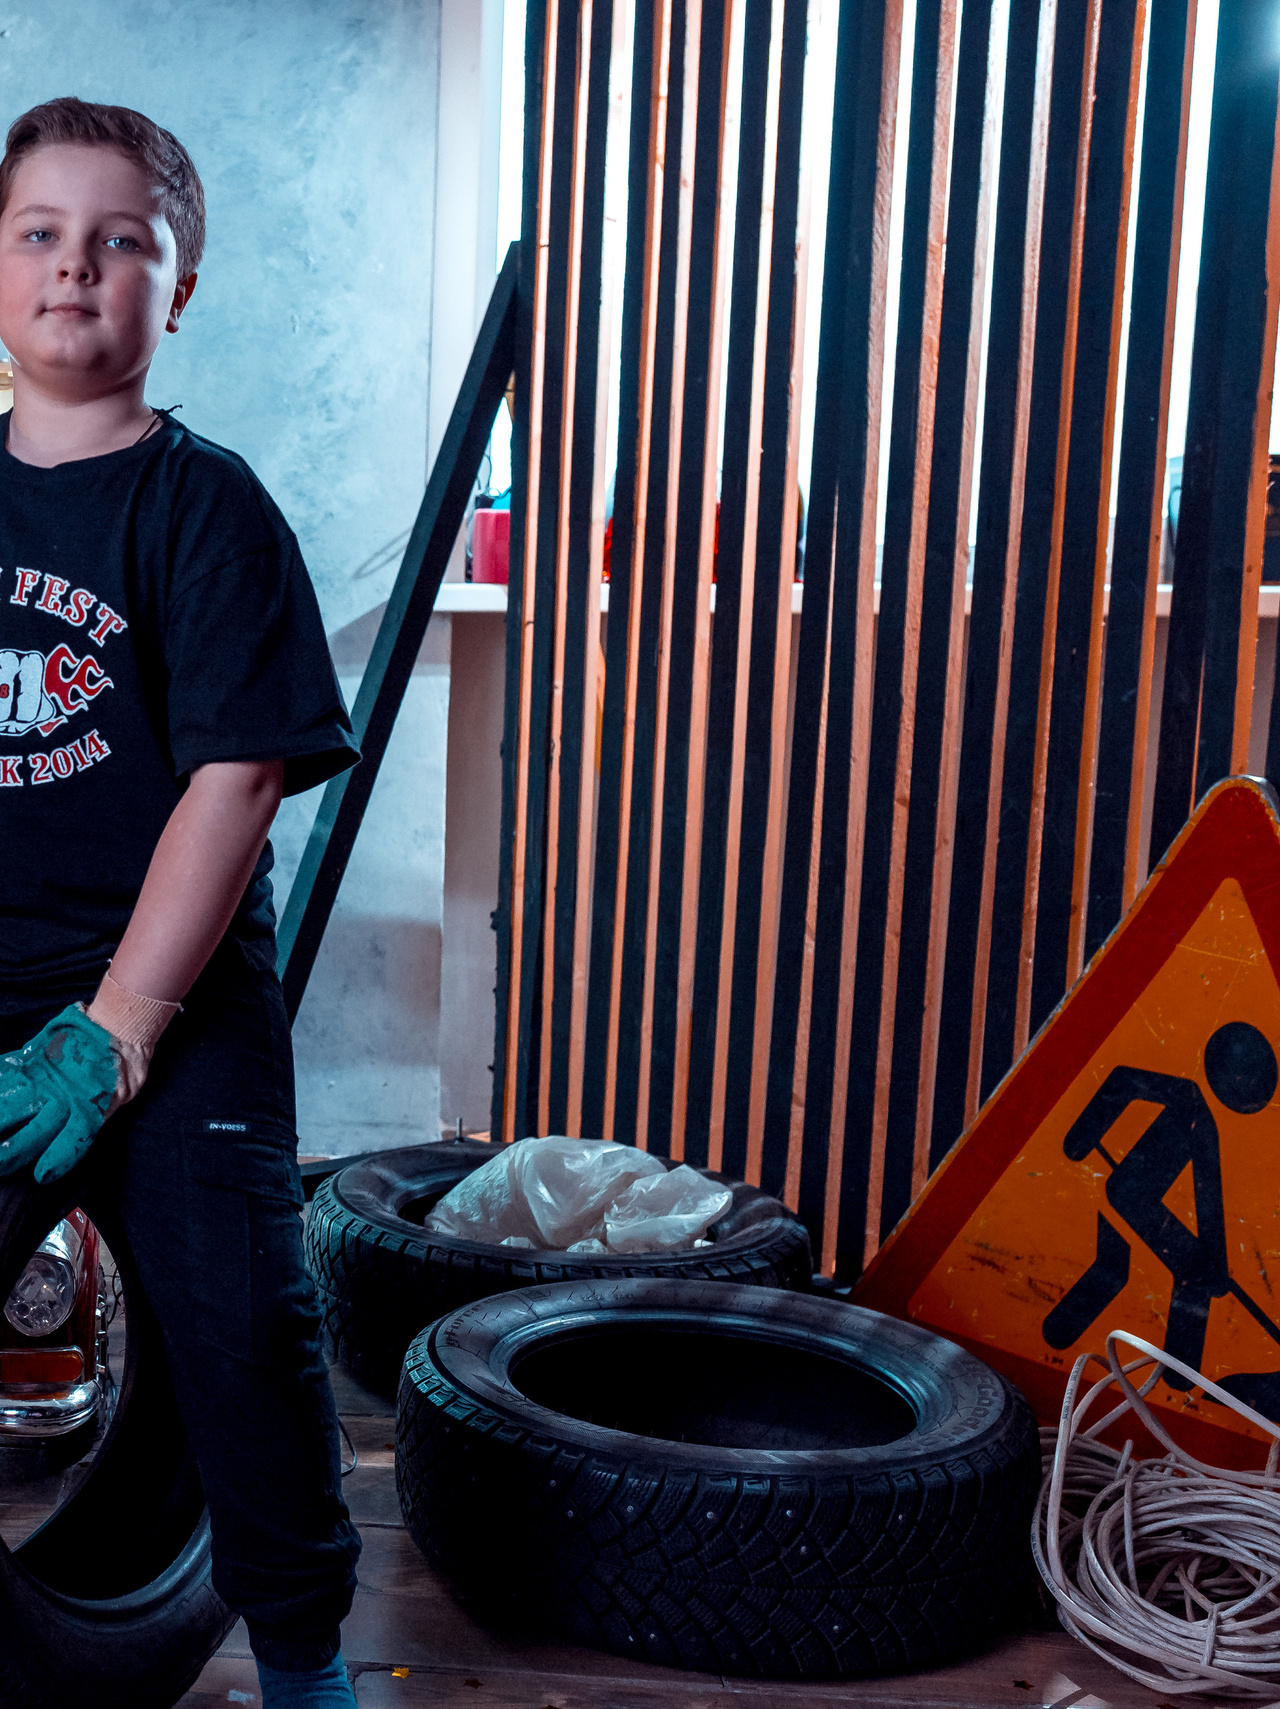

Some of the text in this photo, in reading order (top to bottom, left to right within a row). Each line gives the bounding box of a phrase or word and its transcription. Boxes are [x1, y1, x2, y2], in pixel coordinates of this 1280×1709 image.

[10, 567, 128, 647] FEST
[0, 684, 9, 698] 8
[27, 728, 112, 786] 2014
